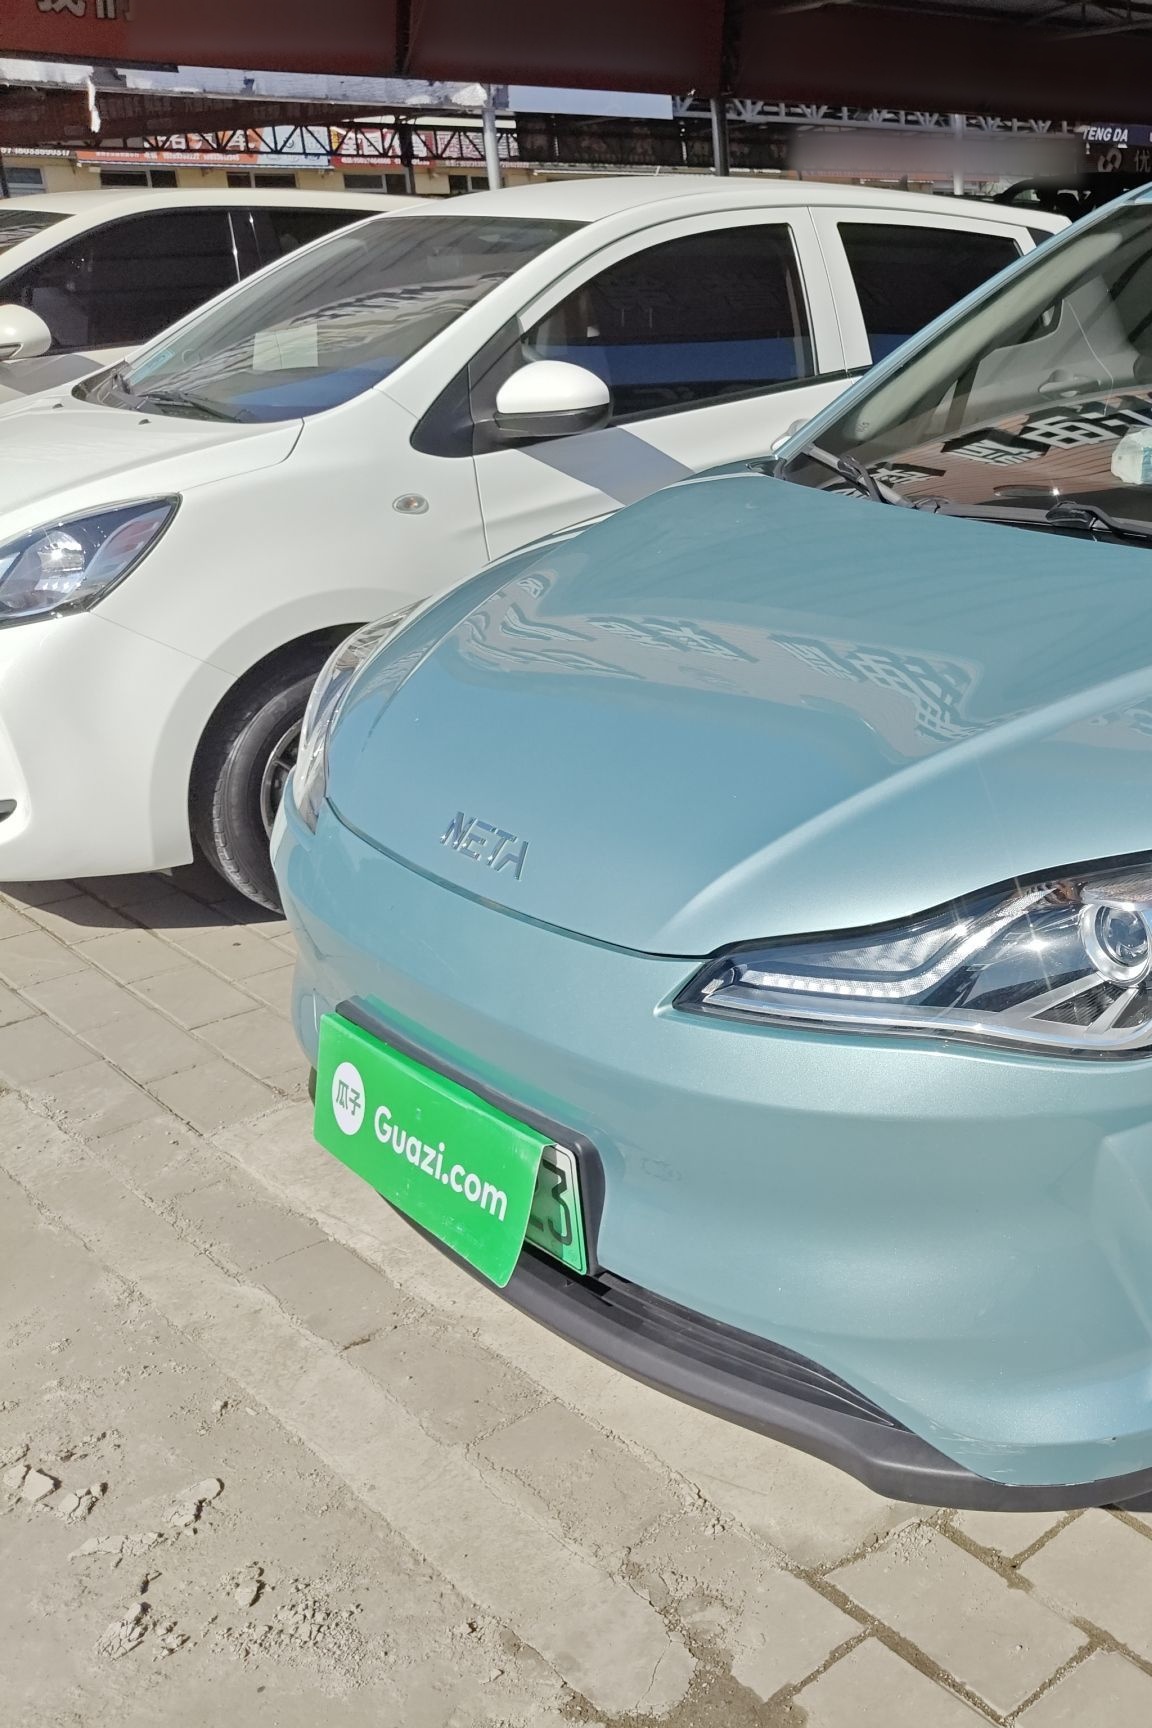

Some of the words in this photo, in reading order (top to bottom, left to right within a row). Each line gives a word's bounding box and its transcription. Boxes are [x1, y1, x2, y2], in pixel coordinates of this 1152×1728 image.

[1083, 127, 1112, 141] TENG
[1113, 128, 1128, 142] DA
[440, 811, 530, 881] NETA
[335, 1078, 363, 1116] 瓜子
[374, 1106, 508, 1222] Guazi.com
